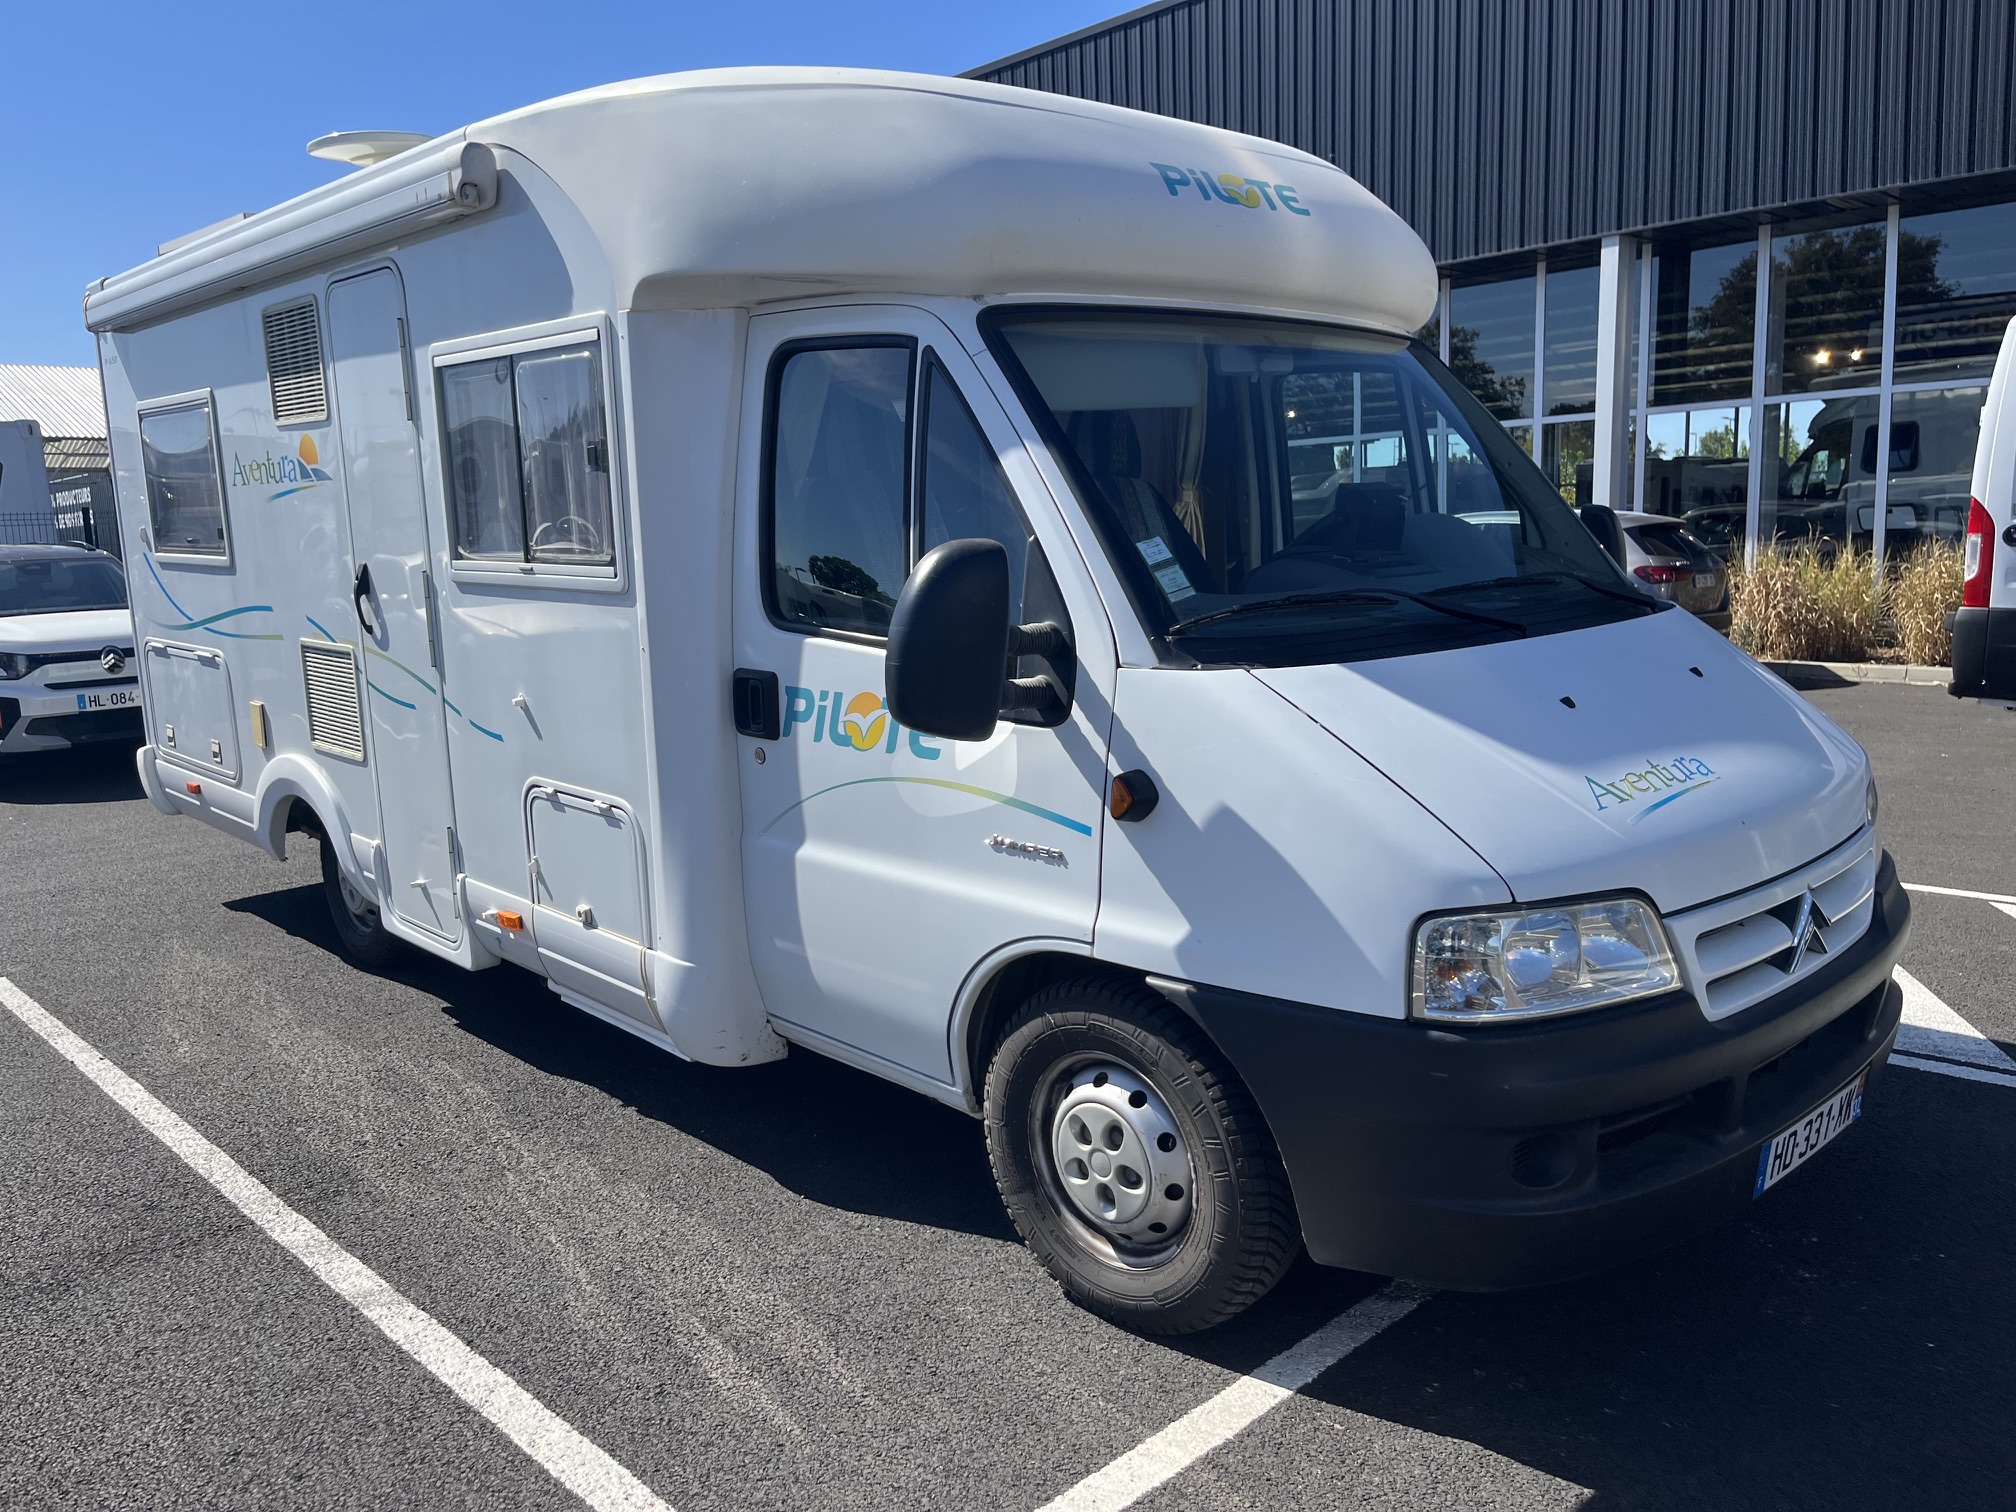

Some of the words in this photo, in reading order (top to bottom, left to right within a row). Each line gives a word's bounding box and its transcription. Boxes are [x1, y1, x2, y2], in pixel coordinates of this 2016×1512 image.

[232, 450, 299, 487] Aventura
[55, 486, 91, 507] PRODUCTEURS
[1584, 756, 1716, 811] Aventura
[984, 833, 1064, 862] JUMPER
